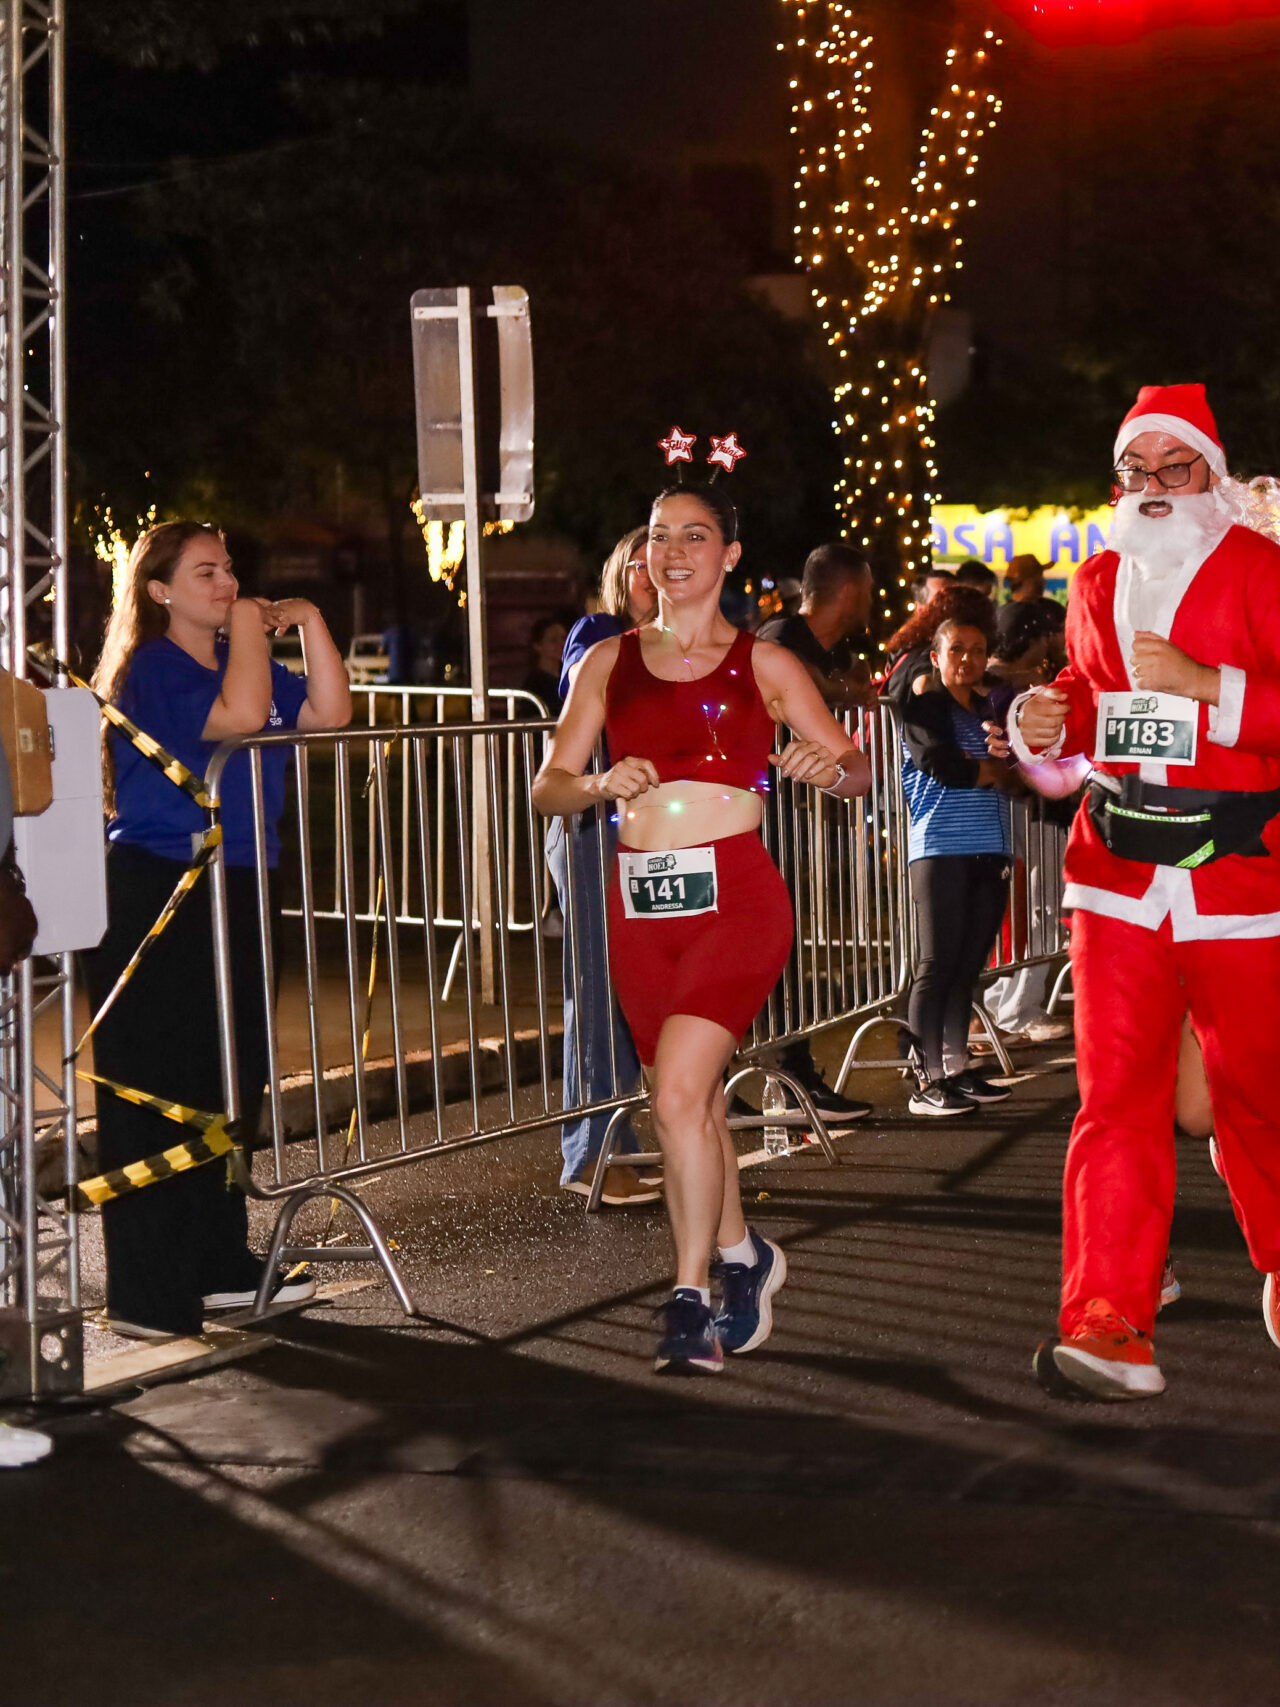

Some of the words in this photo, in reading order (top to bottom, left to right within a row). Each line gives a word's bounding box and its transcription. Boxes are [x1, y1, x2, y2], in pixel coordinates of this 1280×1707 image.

[1116, 720, 1175, 746] 1183
[1128, 747, 1152, 755] RENAN
[644, 877, 686, 901] 141
[651, 902, 683, 911] ANDRESSA
